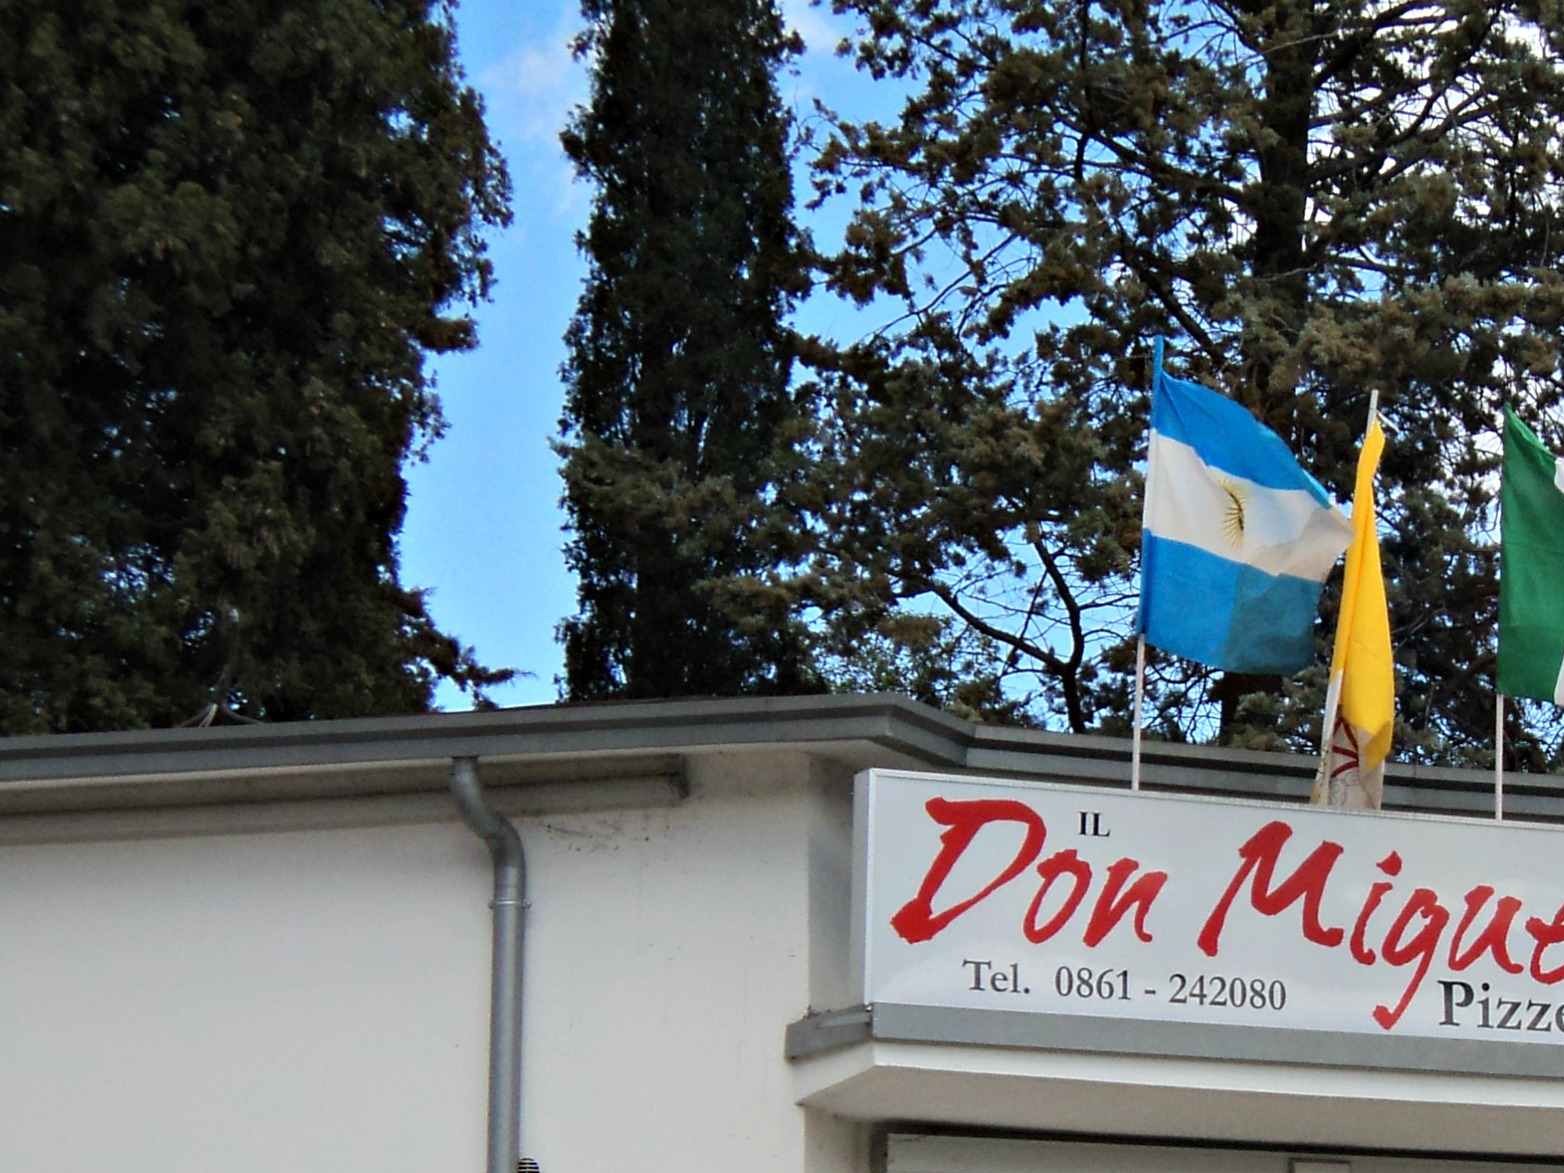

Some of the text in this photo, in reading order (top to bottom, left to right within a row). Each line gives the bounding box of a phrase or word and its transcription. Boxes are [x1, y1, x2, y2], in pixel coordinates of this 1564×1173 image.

[1078, 810, 1111, 838] IL
[890, 796, 1168, 948] Don
[962, 959, 1031, 995] Tel.
[1054, 965, 1133, 1000] 0861
[1168, 974, 1287, 1011] 242080
